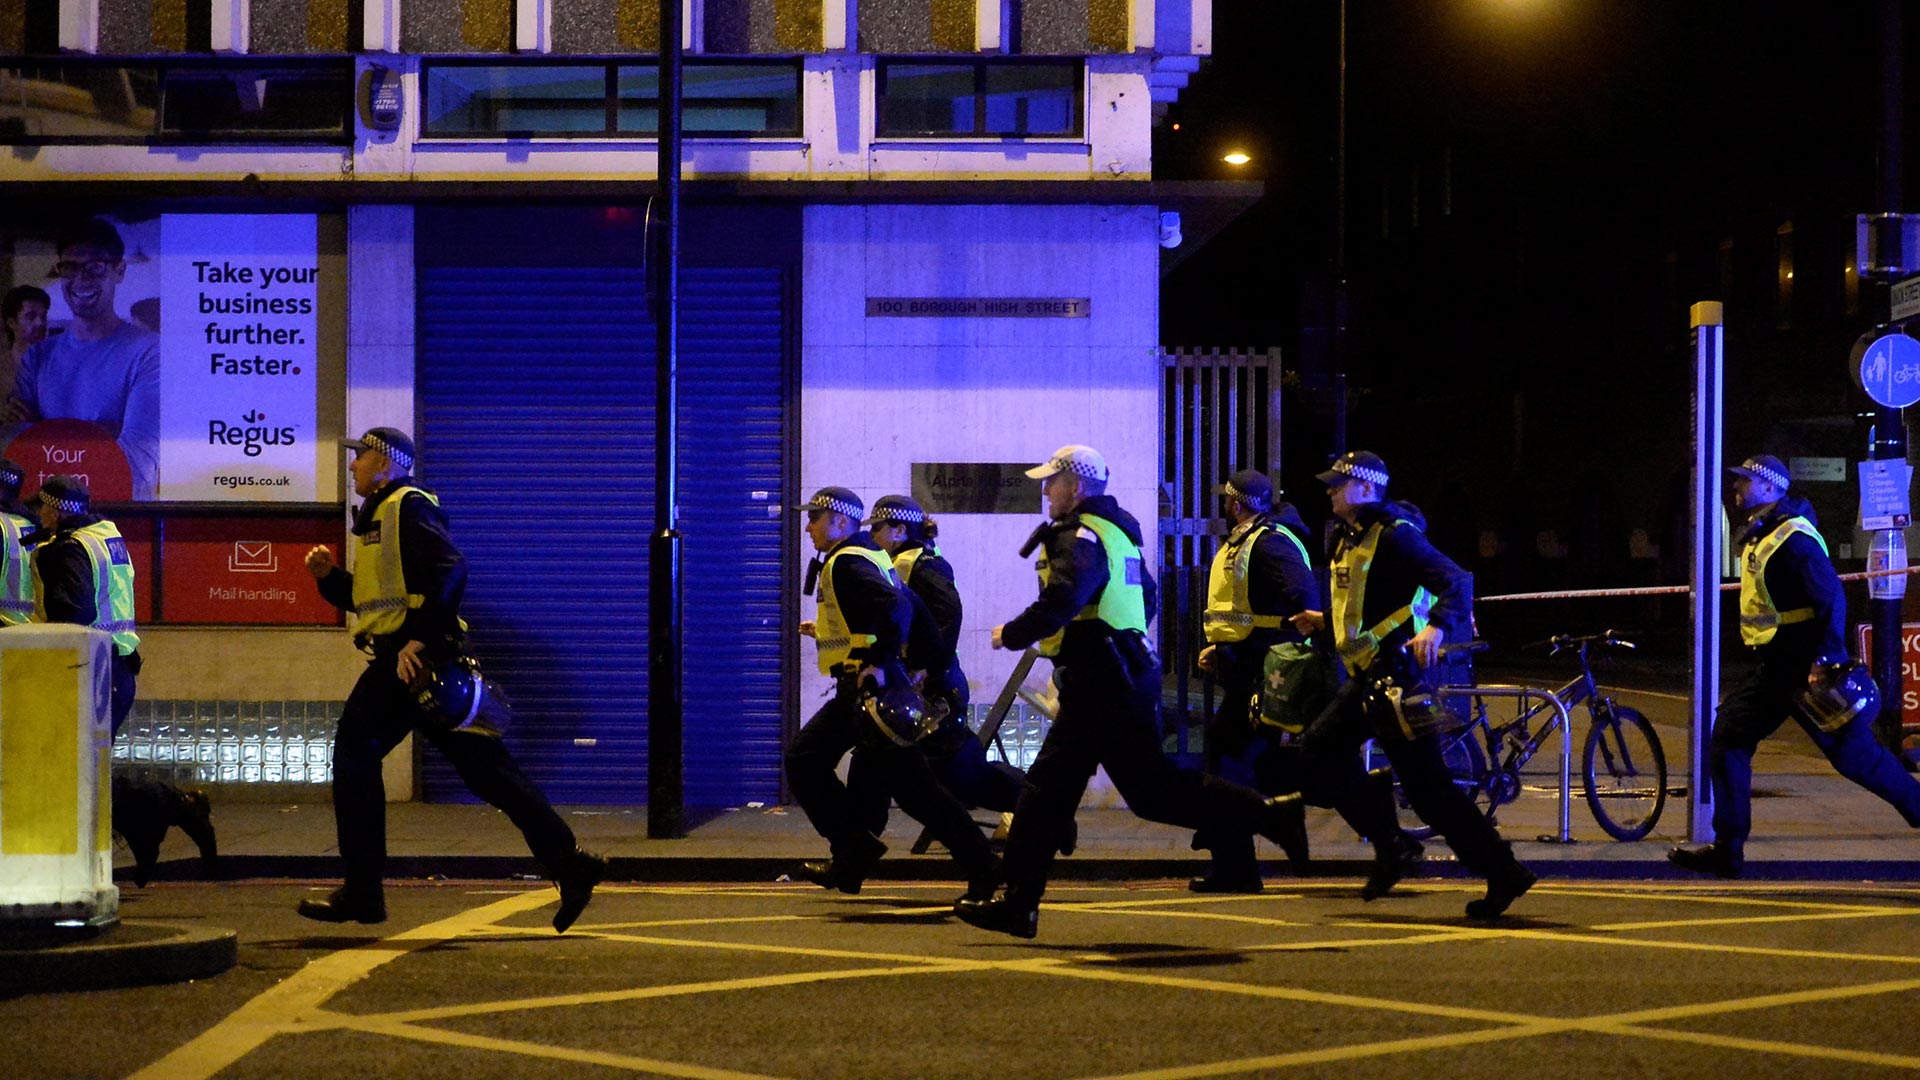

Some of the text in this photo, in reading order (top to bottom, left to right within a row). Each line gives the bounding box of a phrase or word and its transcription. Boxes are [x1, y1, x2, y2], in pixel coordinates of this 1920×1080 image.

[192, 261, 320, 289] Take your
[199, 292, 312, 314] business
[878, 302, 1079, 313] 100 BOROUGH HIGH STREET
[205, 322, 305, 344] further.
[210, 353, 301, 375] Faster.
[209, 420, 296, 457] Regus
[42, 445, 85, 463] Your
[38, 471, 89, 487] tm
[213, 476, 290, 489] regus.co.uk
[932, 474, 973, 490] Alpha
[209, 587, 297, 604] Mail handling
